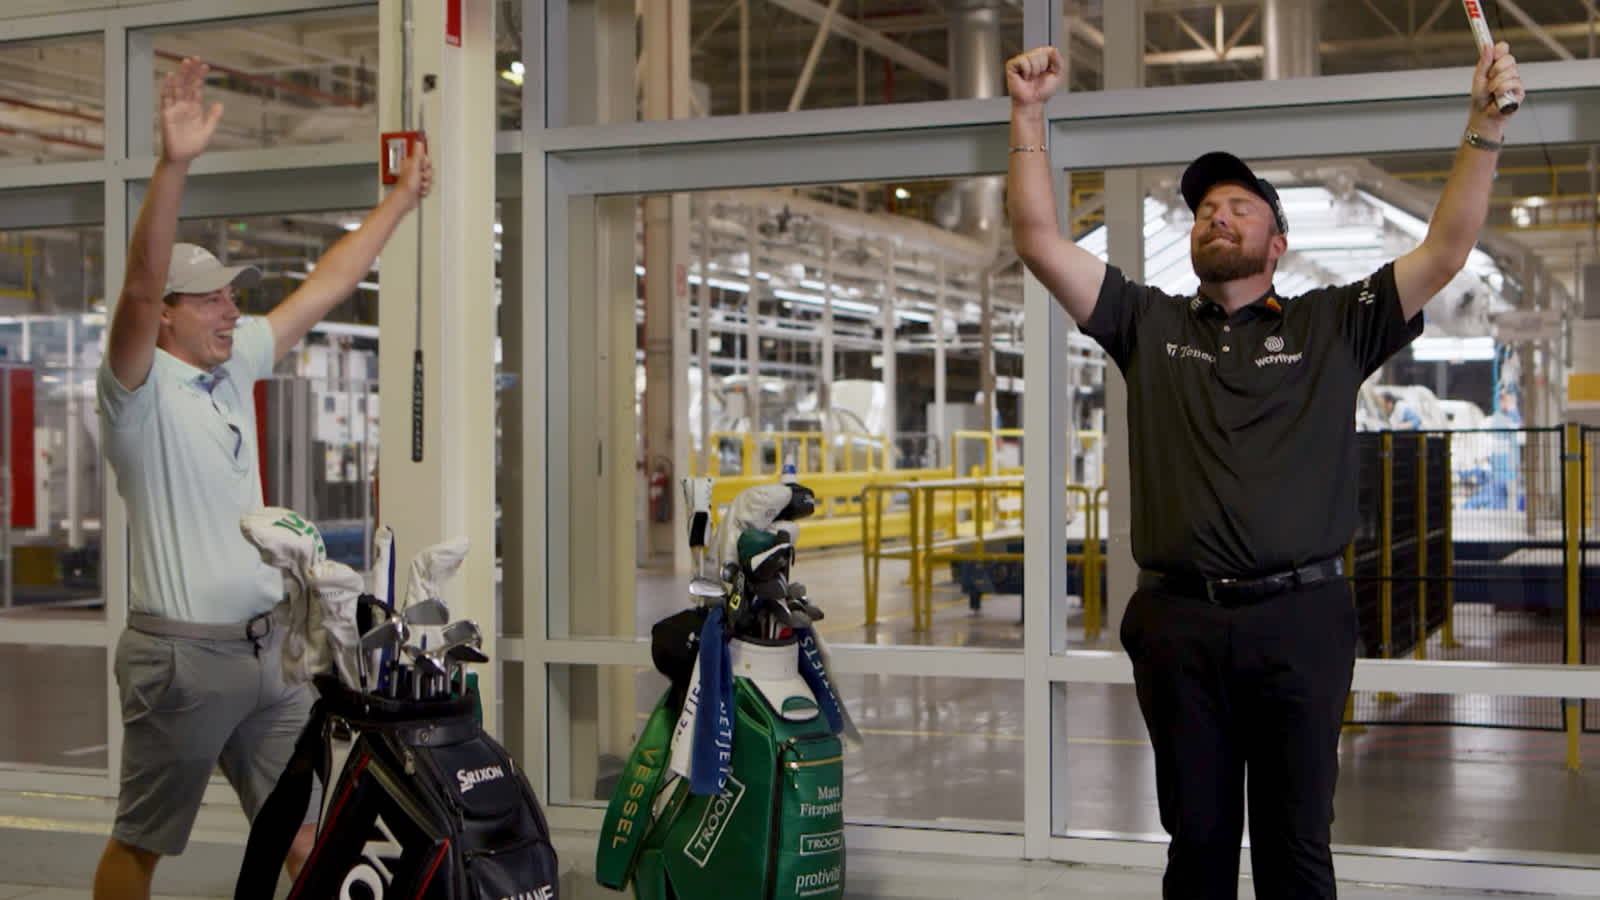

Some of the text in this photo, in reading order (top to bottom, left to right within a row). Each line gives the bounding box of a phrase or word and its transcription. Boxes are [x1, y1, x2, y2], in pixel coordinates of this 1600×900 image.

[1254, 351, 1304, 368] wayflyer
[456, 766, 505, 793] SRIXON
[612, 747, 659, 849] VESSEL
[694, 788, 735, 851] TROON
